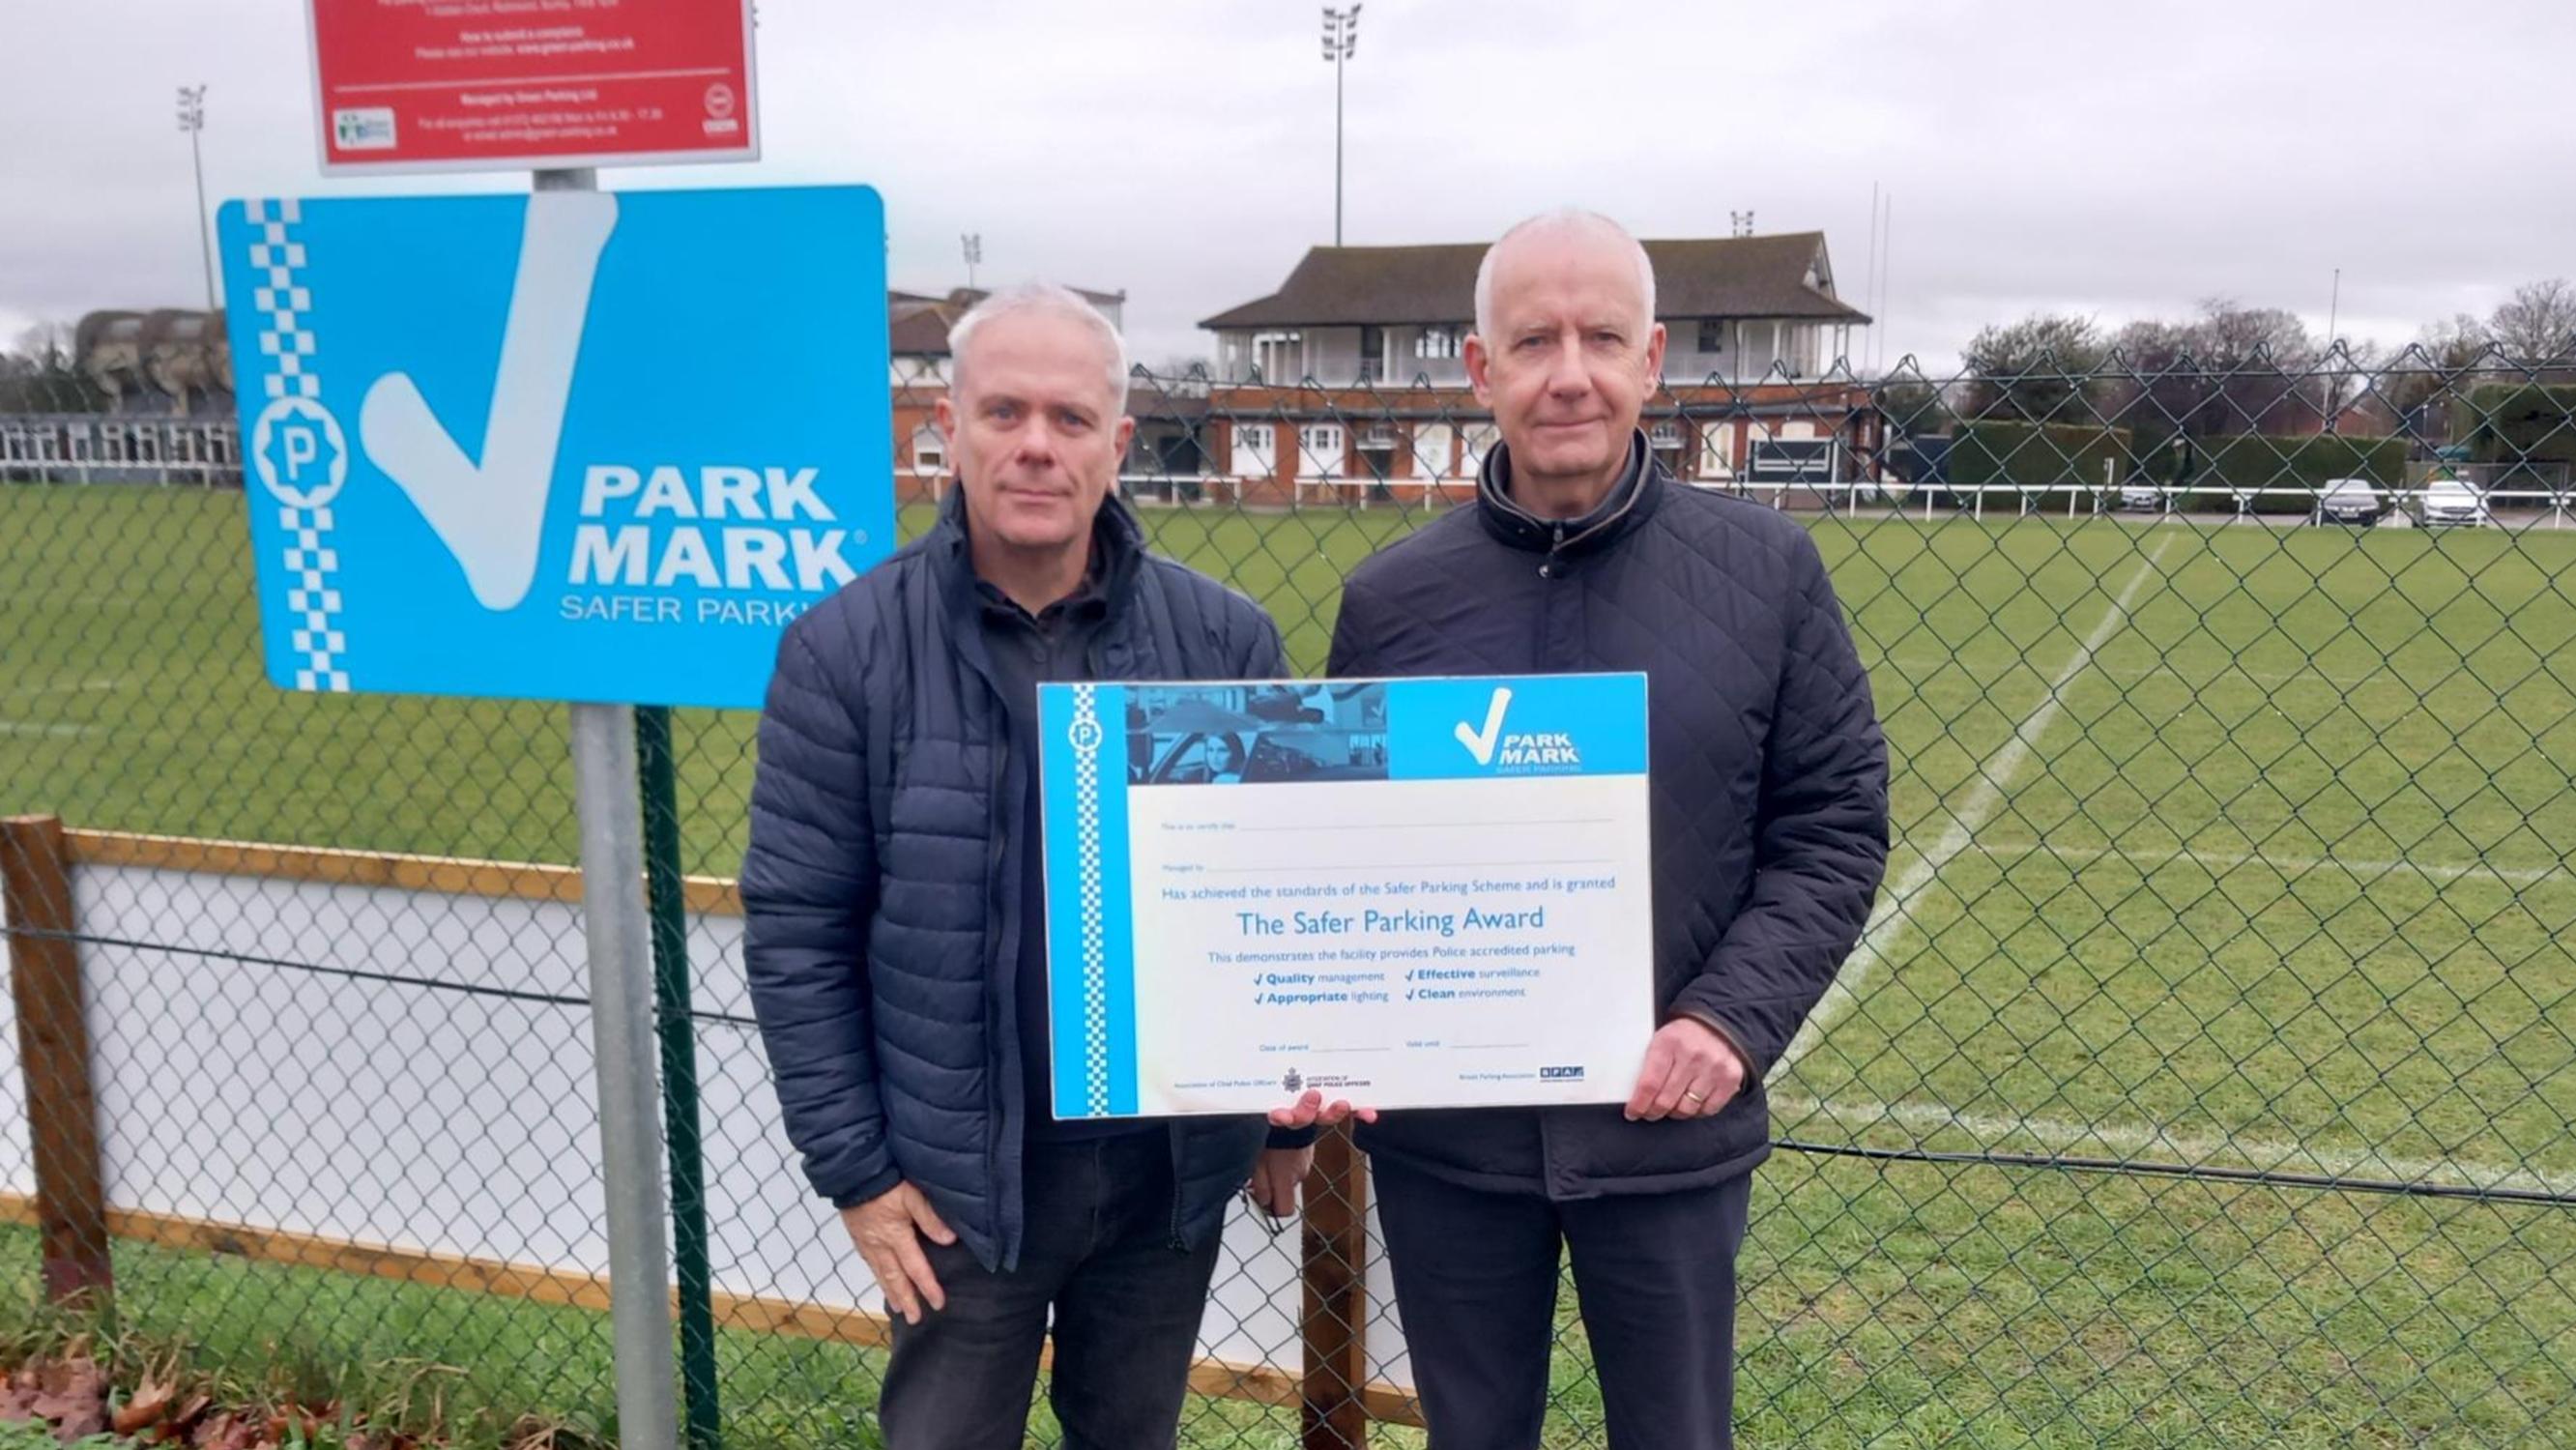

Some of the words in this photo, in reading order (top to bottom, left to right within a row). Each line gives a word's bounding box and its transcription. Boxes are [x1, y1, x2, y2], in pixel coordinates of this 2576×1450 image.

[580, 465, 837, 521] PARK
[567, 525, 859, 592] MARK
[559, 594, 680, 623] SAFER
[698, 597, 809, 626] PARK
[1504, 733, 1572, 748] PARK
[1499, 747, 1580, 765] MARK
[1162, 888, 1187, 900] Has
[1190, 884, 1246, 899] achieved
[1251, 885, 1271, 898] the
[1276, 884, 1337, 898] standards
[1342, 883, 1357, 895] of
[1359, 882, 1379, 895] the
[1384, 881, 1415, 894] Safer
[1421, 880, 1468, 895] Parking
[1472, 879, 1522, 892] Scheme
[1526, 877, 1548, 890] and
[1552, 877, 1562, 889] is
[1567, 876, 1616, 892] granted
[1237, 912, 1285, 936] The
[1293, 908, 1354, 936] Safer
[1364, 907, 1454, 938] Parking
[1462, 905, 1545, 930] Award
[1207, 951, 1231, 963] This
[1235, 950, 1314, 963] demonstrates
[1318, 949, 1338, 961] the
[1340, 948, 1376, 963] facility
[1379, 946, 1429, 962] provides
[1433, 945, 1466, 958] Police
[1469, 944, 1529, 957] accredited
[1533, 942, 1576, 958] parking
[1266, 972, 1315, 986] Quality
[1317, 972, 1385, 984] management
[1418, 969, 1475, 980] Effective
[1479, 967, 1540, 978] surveillance
[1267, 992, 1347, 1005] Appropriate
[1351, 991, 1389, 1004] lighting
[1418, 988, 1456, 1000] Clean
[1459, 987, 1526, 999] environment
